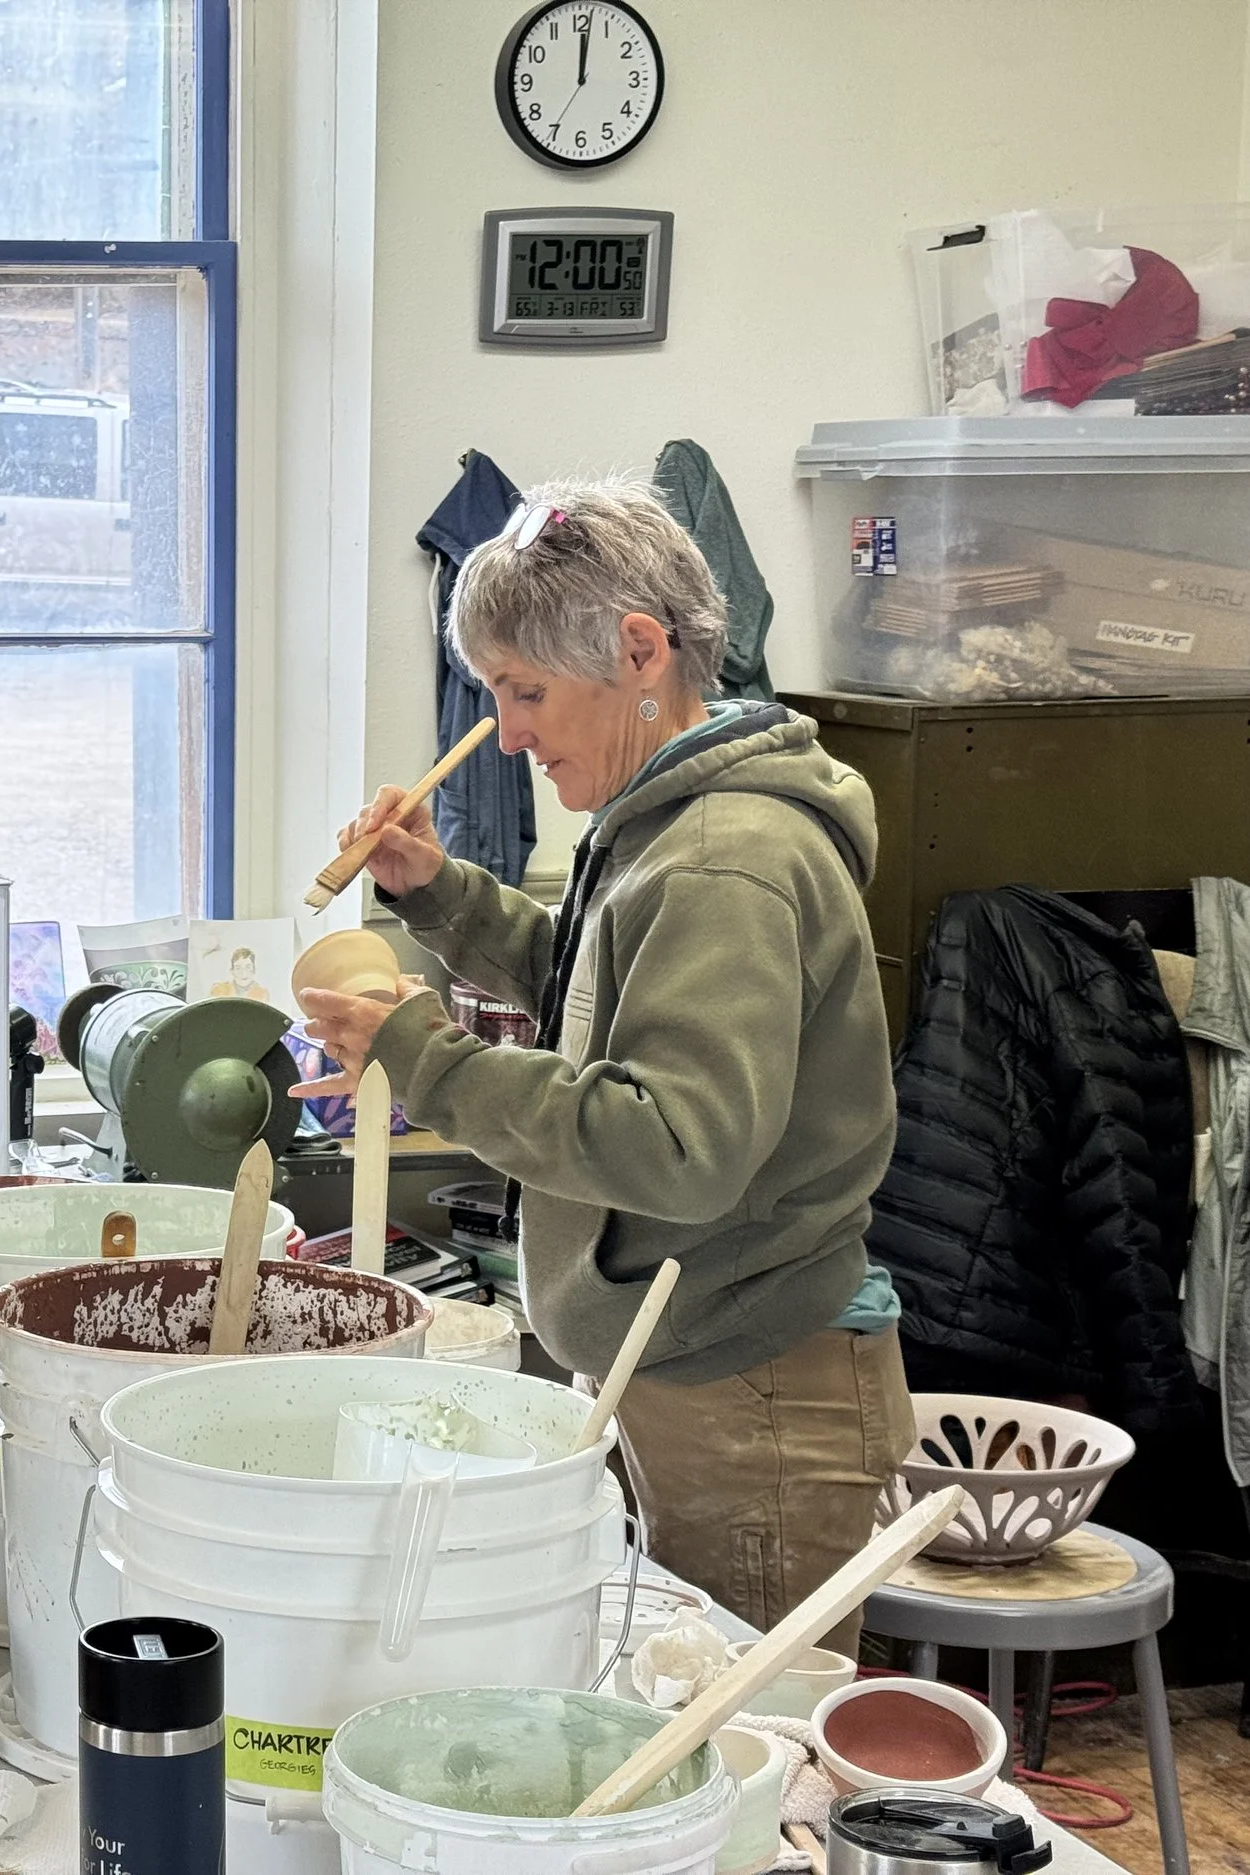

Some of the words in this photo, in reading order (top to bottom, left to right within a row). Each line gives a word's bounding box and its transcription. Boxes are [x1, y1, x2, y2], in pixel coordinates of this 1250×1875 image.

[550, 22, 558, 40] 11
[573, 14, 589, 33] 12
[604, 20, 609, 38] 1
[528, 45, 546, 64] 10
[620, 41, 633, 59] 2
[520, 73, 533, 92] 9
[628, 71, 640, 88] 3
[529, 103, 542, 121] 8
[620, 100, 633, 118] 4
[548, 124, 560, 142] 7
[575, 130, 587, 148] 6
[601, 122, 614, 140] 5
[528, 240, 623, 290] 12:00
[260, 1758, 316, 1776] GEORGIES
[88, 1825, 126, 1856] Your
[100, 1860, 132, 1875] Lif
